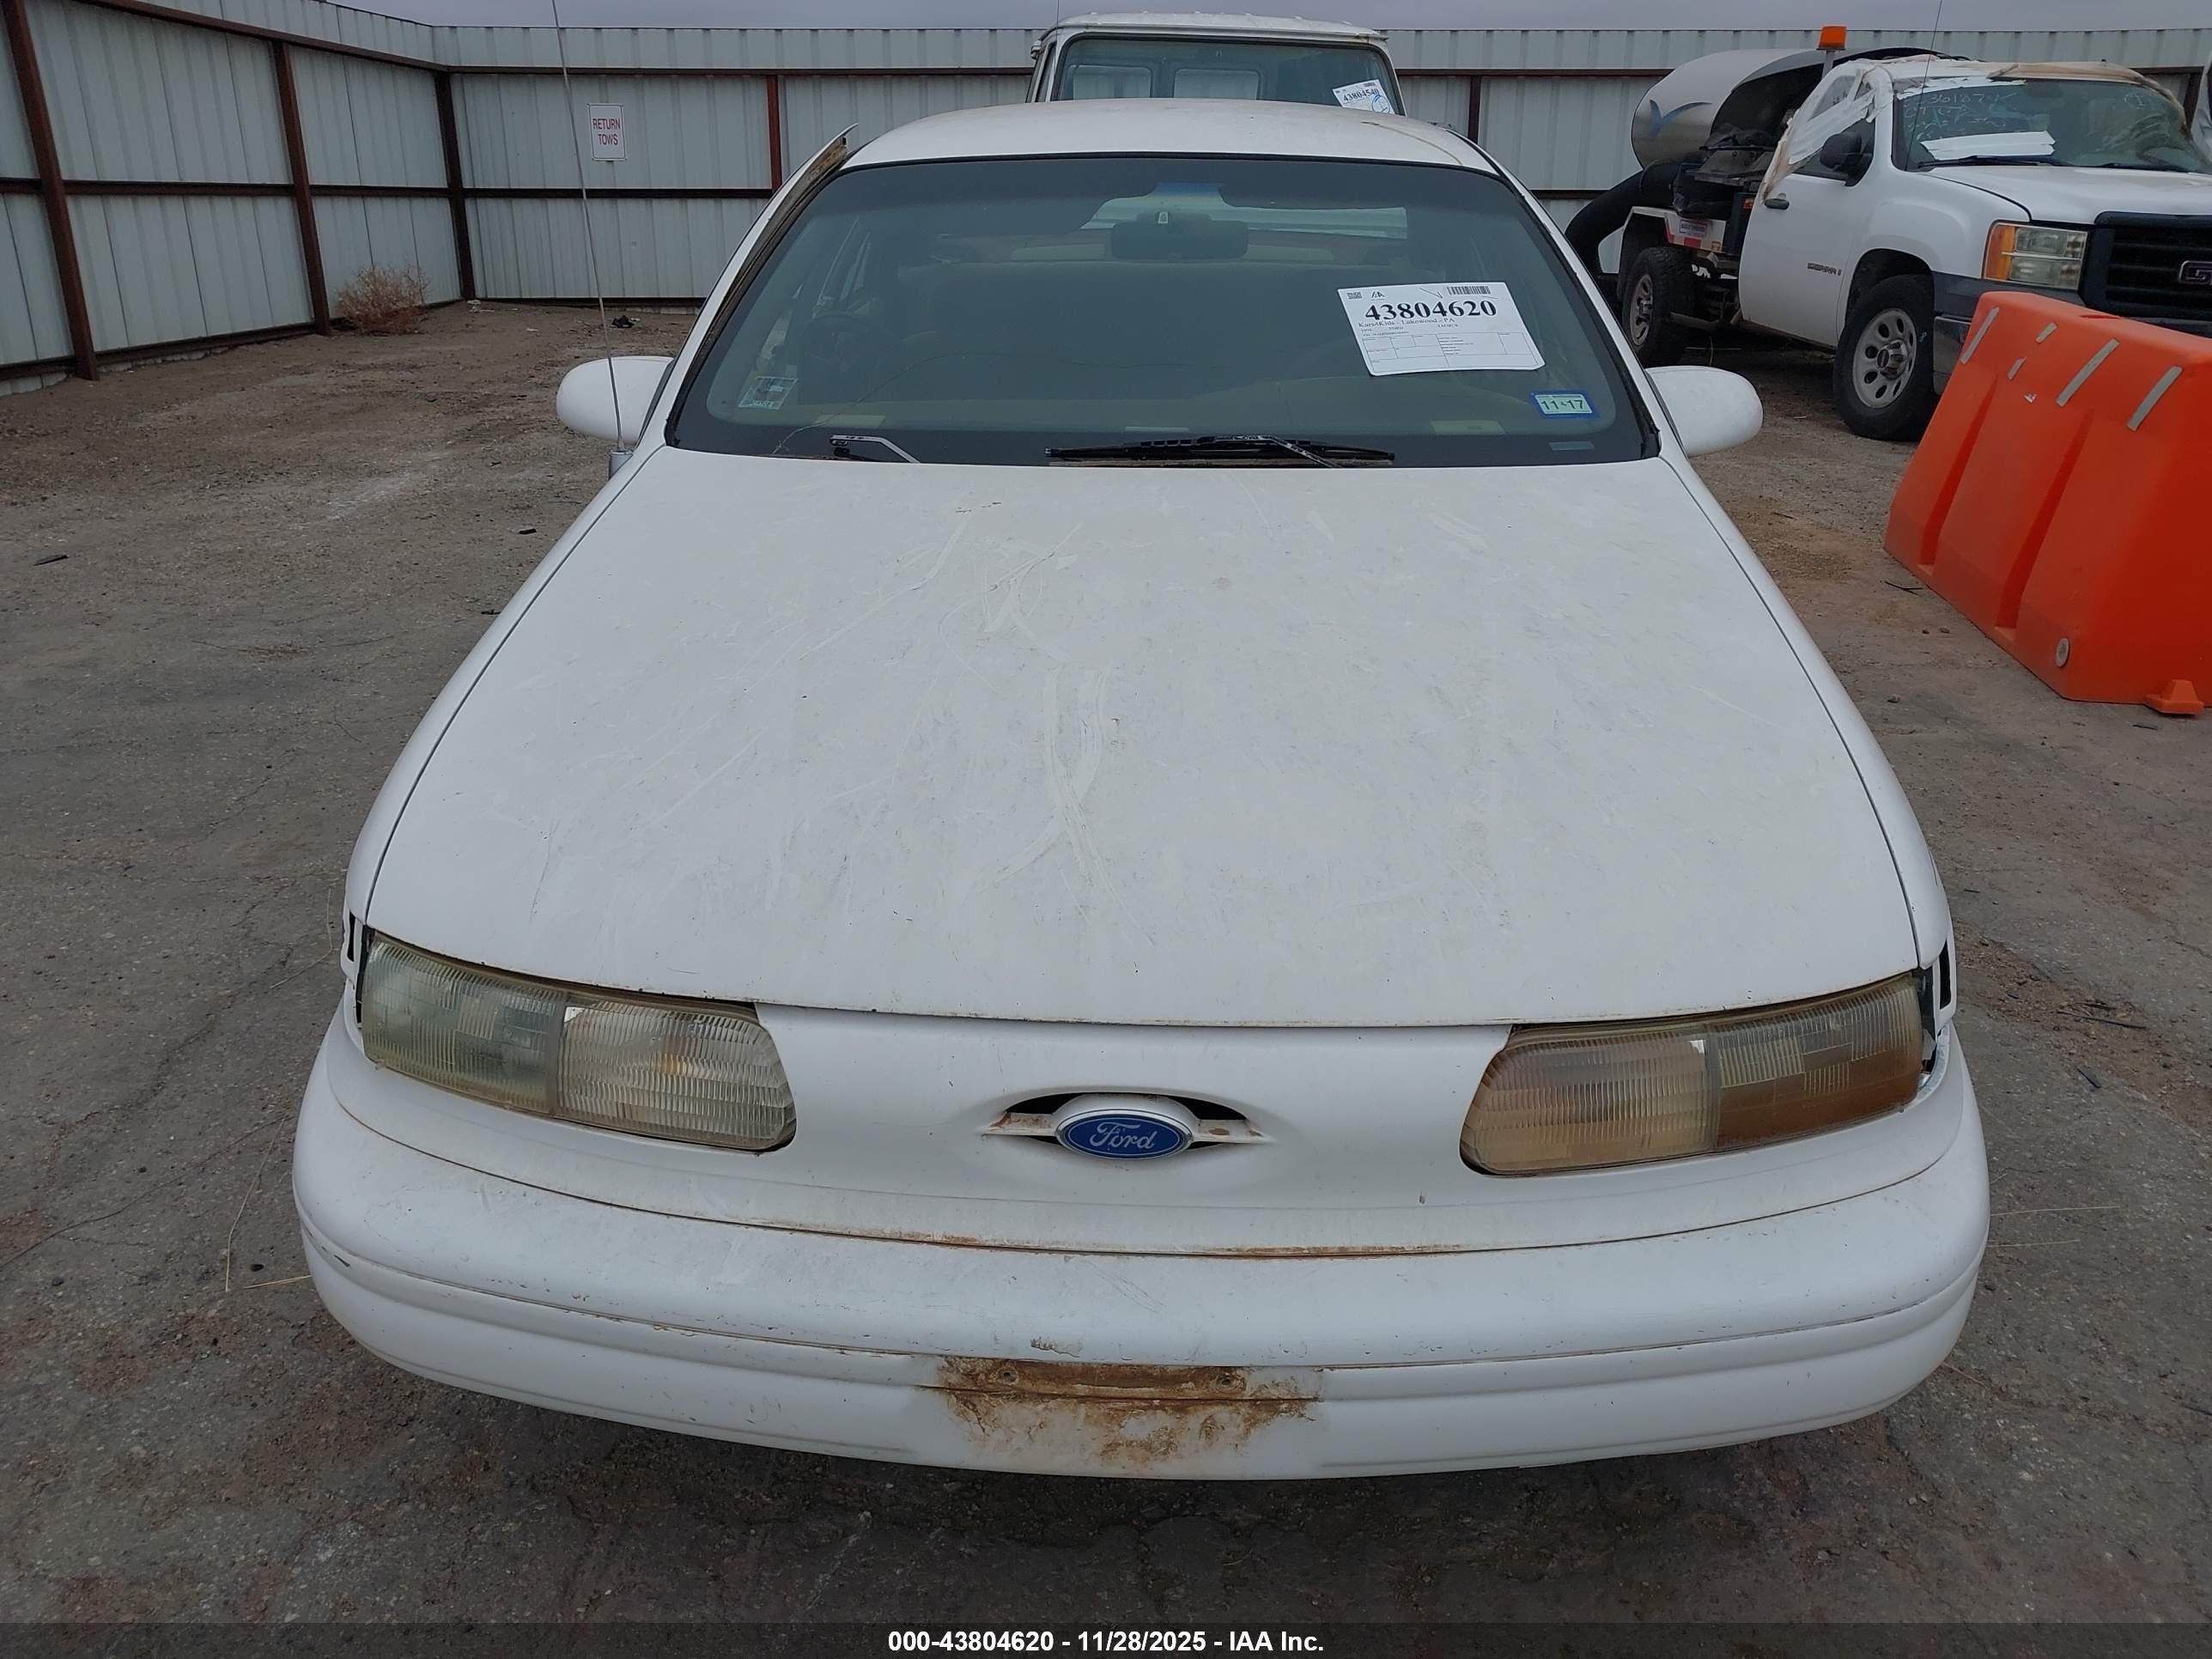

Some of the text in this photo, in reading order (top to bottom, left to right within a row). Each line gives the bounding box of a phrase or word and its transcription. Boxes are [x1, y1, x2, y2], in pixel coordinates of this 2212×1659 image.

[592, 118, 621, 130] RETURN
[598, 133, 618, 145] TOWS
[1365, 301, 1497, 320] 43804620
[1090, 1121, 1158, 1149] Ford
